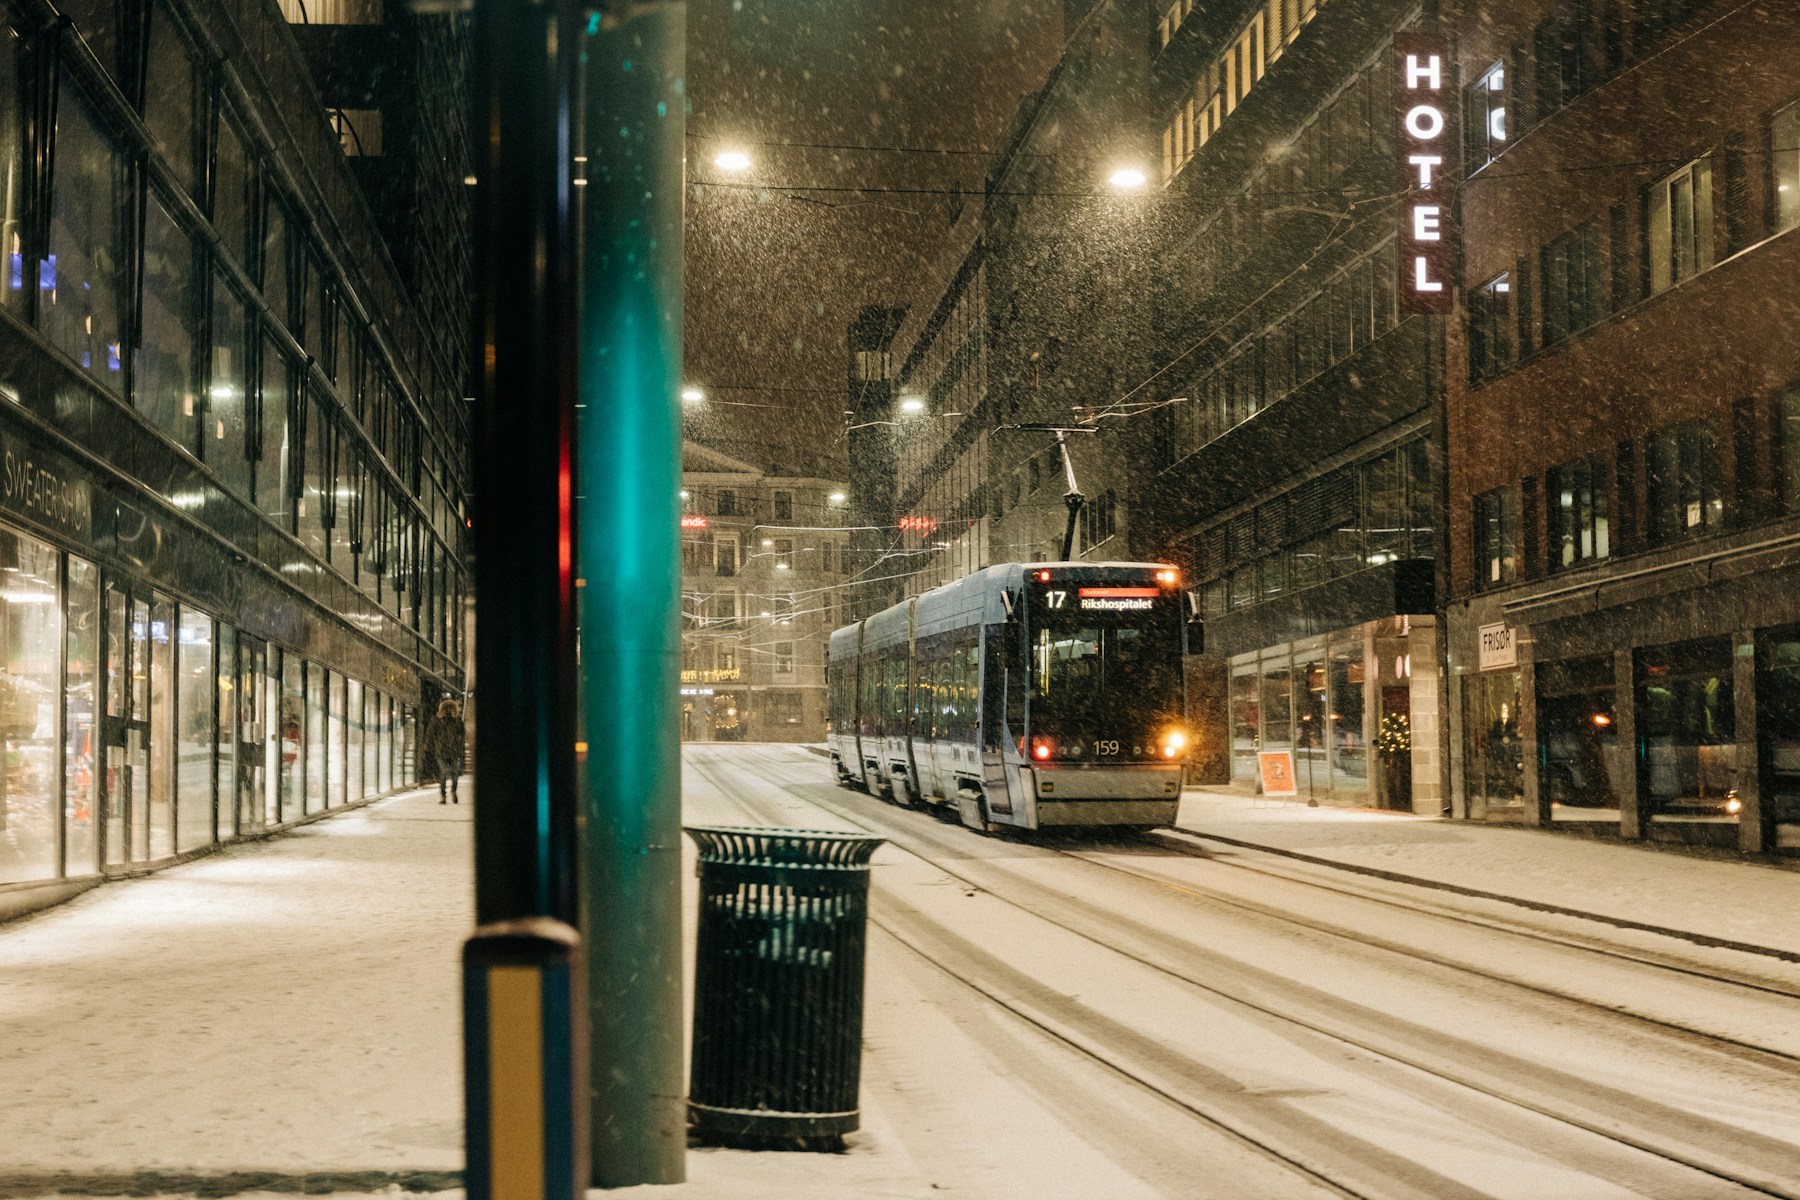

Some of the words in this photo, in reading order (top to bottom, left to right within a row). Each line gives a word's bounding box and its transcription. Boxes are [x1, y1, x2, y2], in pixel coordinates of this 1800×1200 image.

[1406, 55, 1443, 291] HOTEL
[5, 450, 58, 519] SWEATER
[680, 516, 706, 527] andic
[1045, 591, 1066, 608] 17
[1081, 598, 1153, 611] Rikshospitalet
[1093, 740, 1120, 755] 159
